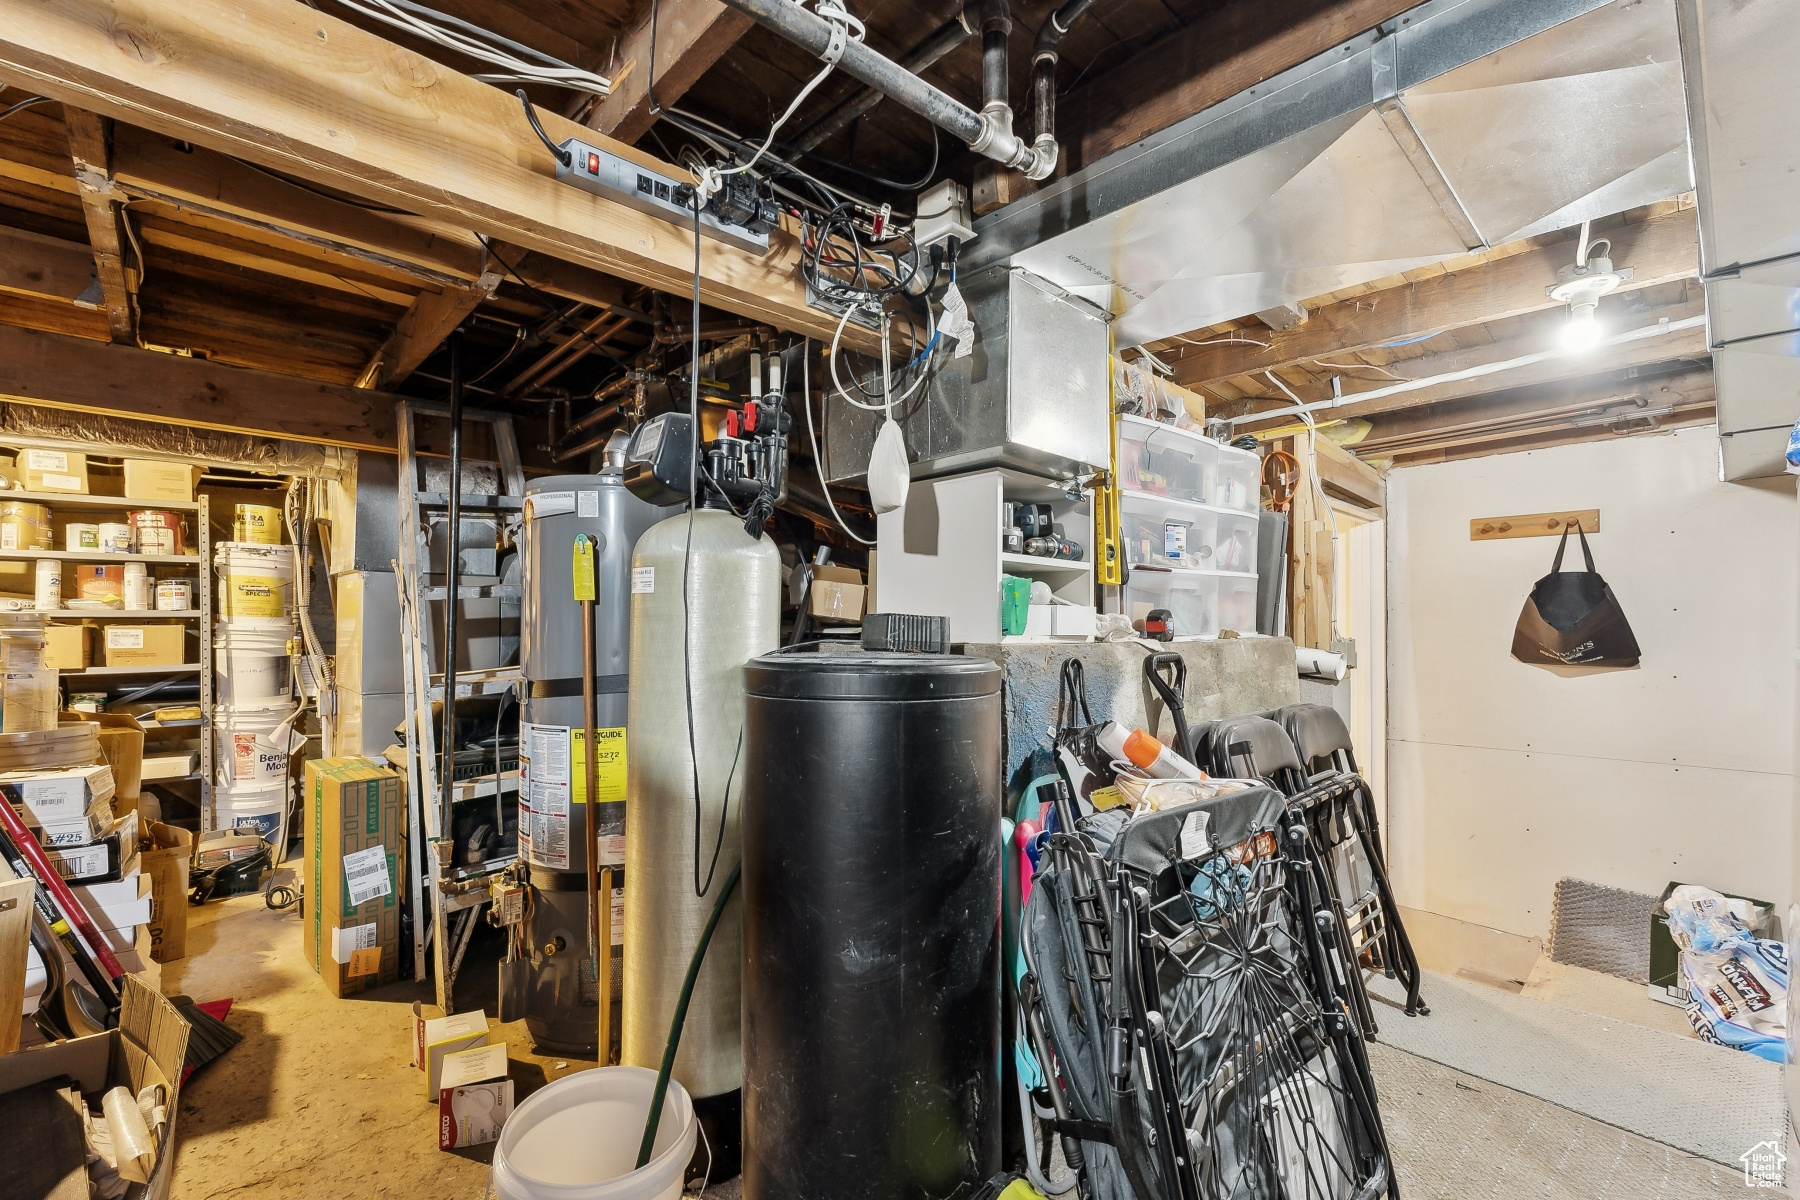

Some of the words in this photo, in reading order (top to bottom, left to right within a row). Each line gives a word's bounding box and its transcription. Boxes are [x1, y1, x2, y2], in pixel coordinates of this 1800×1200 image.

[87, 578, 116, 588] Solo
[259, 752, 288, 763] Benja
[441, 1115, 450, 1141] SATCO
